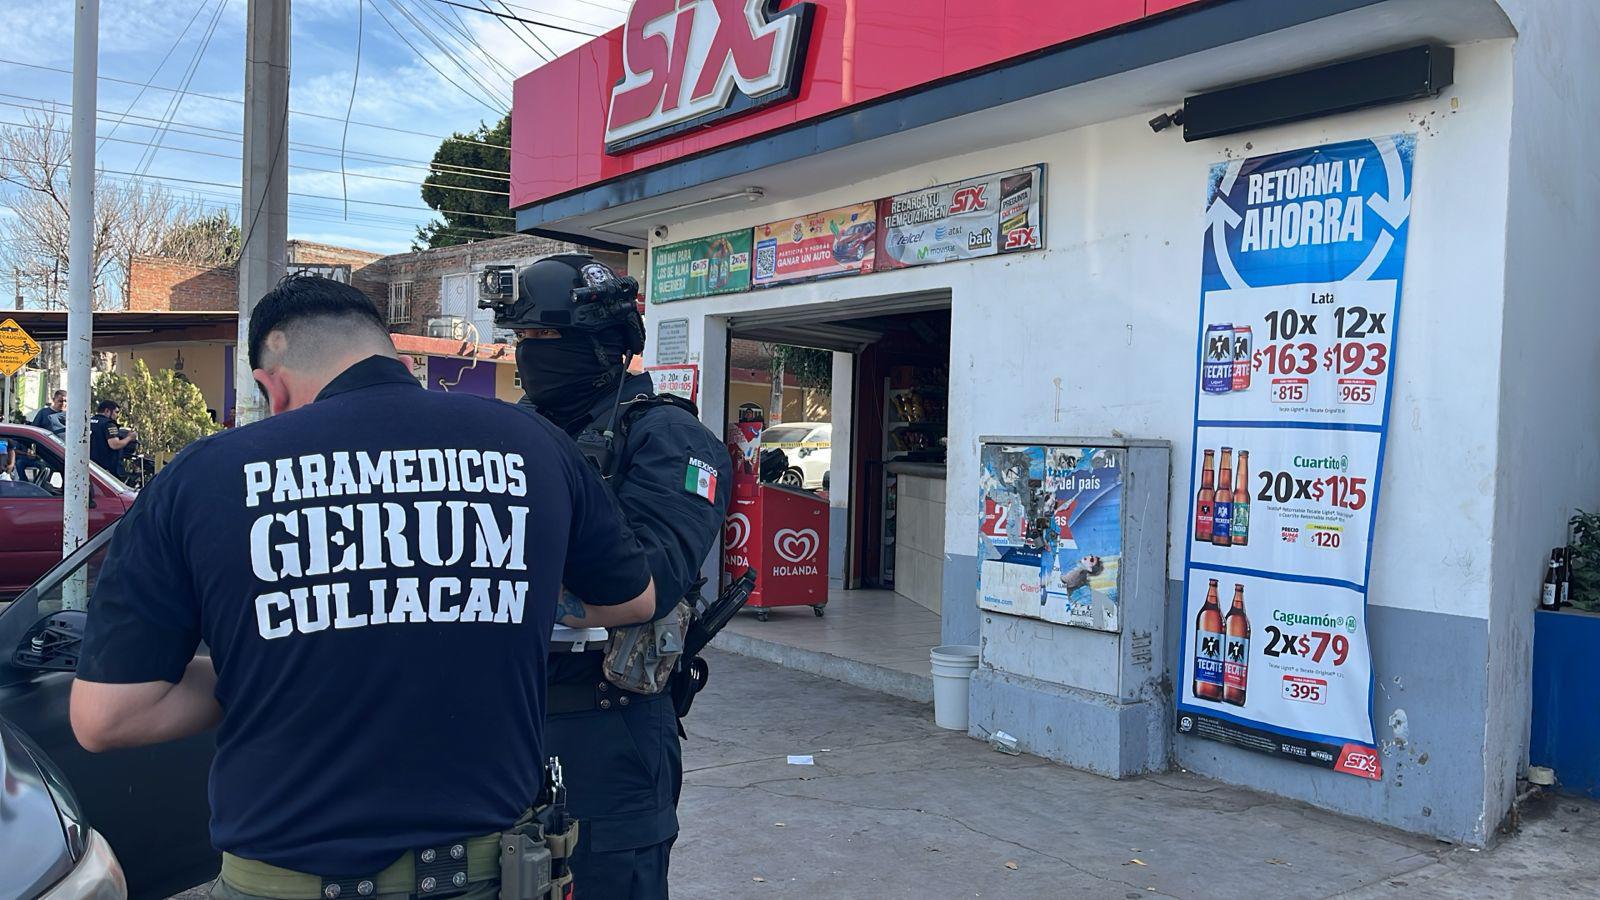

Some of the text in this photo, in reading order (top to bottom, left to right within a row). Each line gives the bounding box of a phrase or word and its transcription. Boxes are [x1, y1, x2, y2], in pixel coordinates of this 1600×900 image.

[1248, 158, 1365, 205] RETORNA Y
[892, 192, 940, 214] RECARGA TU
[1003, 191, 1028, 208] PREGUNTA
[885, 205, 947, 228] TIEMPO AIRE EN
[1241, 196, 1363, 253] AHORRA
[897, 230, 924, 245] telcel
[969, 227, 992, 245] bait
[777, 250, 831, 267] GANAR UN AUTO
[1311, 292, 1336, 304] Lata
[1264, 307, 1387, 341] 10x 12x
[1253, 343, 1387, 375] $163 $193
[1204, 365, 1232, 378] TECATE
[1279, 386, 1303, 400] 815
[1342, 386, 1371, 402] 965
[689, 457, 718, 477] MEXICO
[1293, 455, 1340, 470] Cuartito
[244, 449, 527, 507] PARAMEDICOS
[1079, 475, 1101, 492] país
[250, 501, 530, 582] GERUM
[1310, 532, 1340, 548] $120
[773, 566, 818, 576] HOLANDA
[255, 577, 528, 640] CULIACAN
[1197, 658, 1223, 673] TECATE
[1225, 662, 1247, 677] TECATE
[1290, 683, 1320, 701] 395
